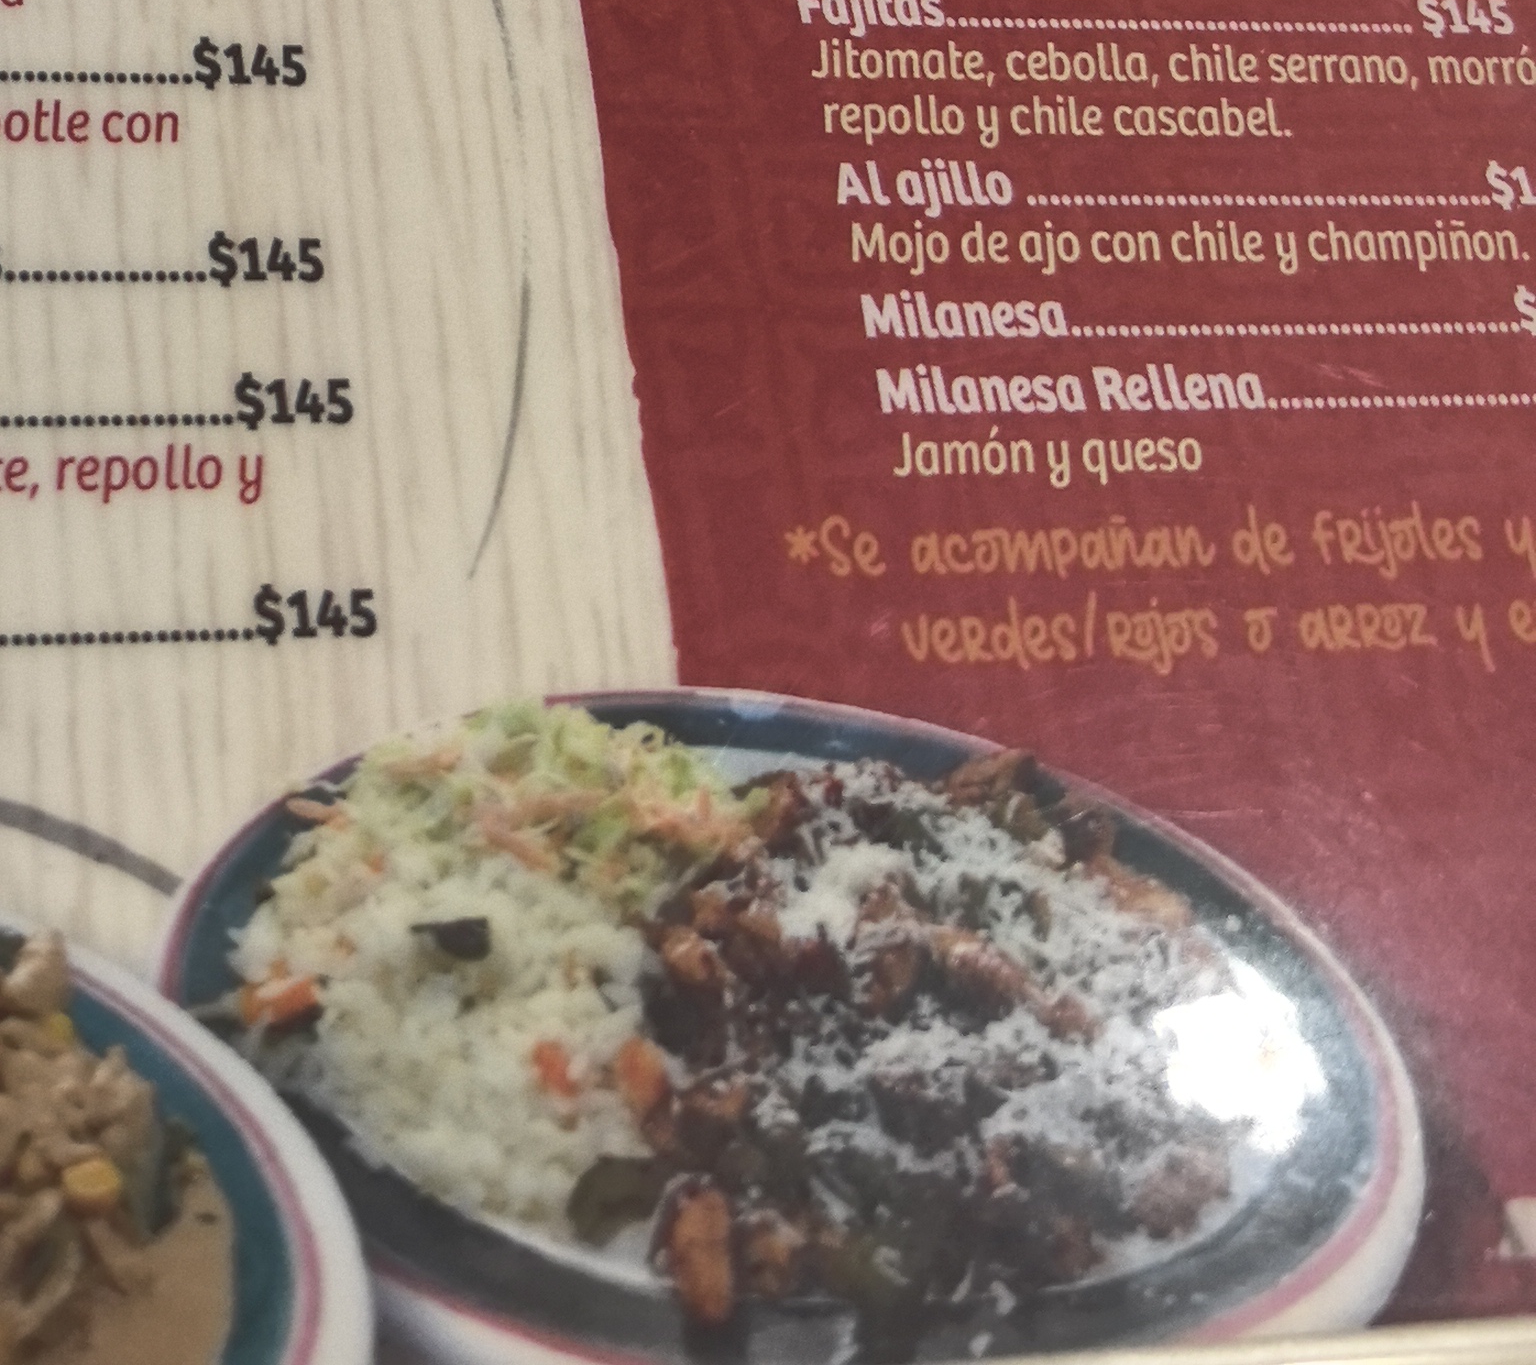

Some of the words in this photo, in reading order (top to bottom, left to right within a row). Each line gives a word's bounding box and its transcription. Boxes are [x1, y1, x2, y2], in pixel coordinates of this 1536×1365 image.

[823, 93, 967, 146] repollo
[976, 105, 1000, 150] y
[1009, 95, 1105, 137] chile
[1113, 96, 1294, 138] cascabel.
[208, 236, 327, 286] $145
[911, 526, 1216, 577] acompañan
[1232, 505, 1294, 574] de
[253, 583, 378, 646] $145
